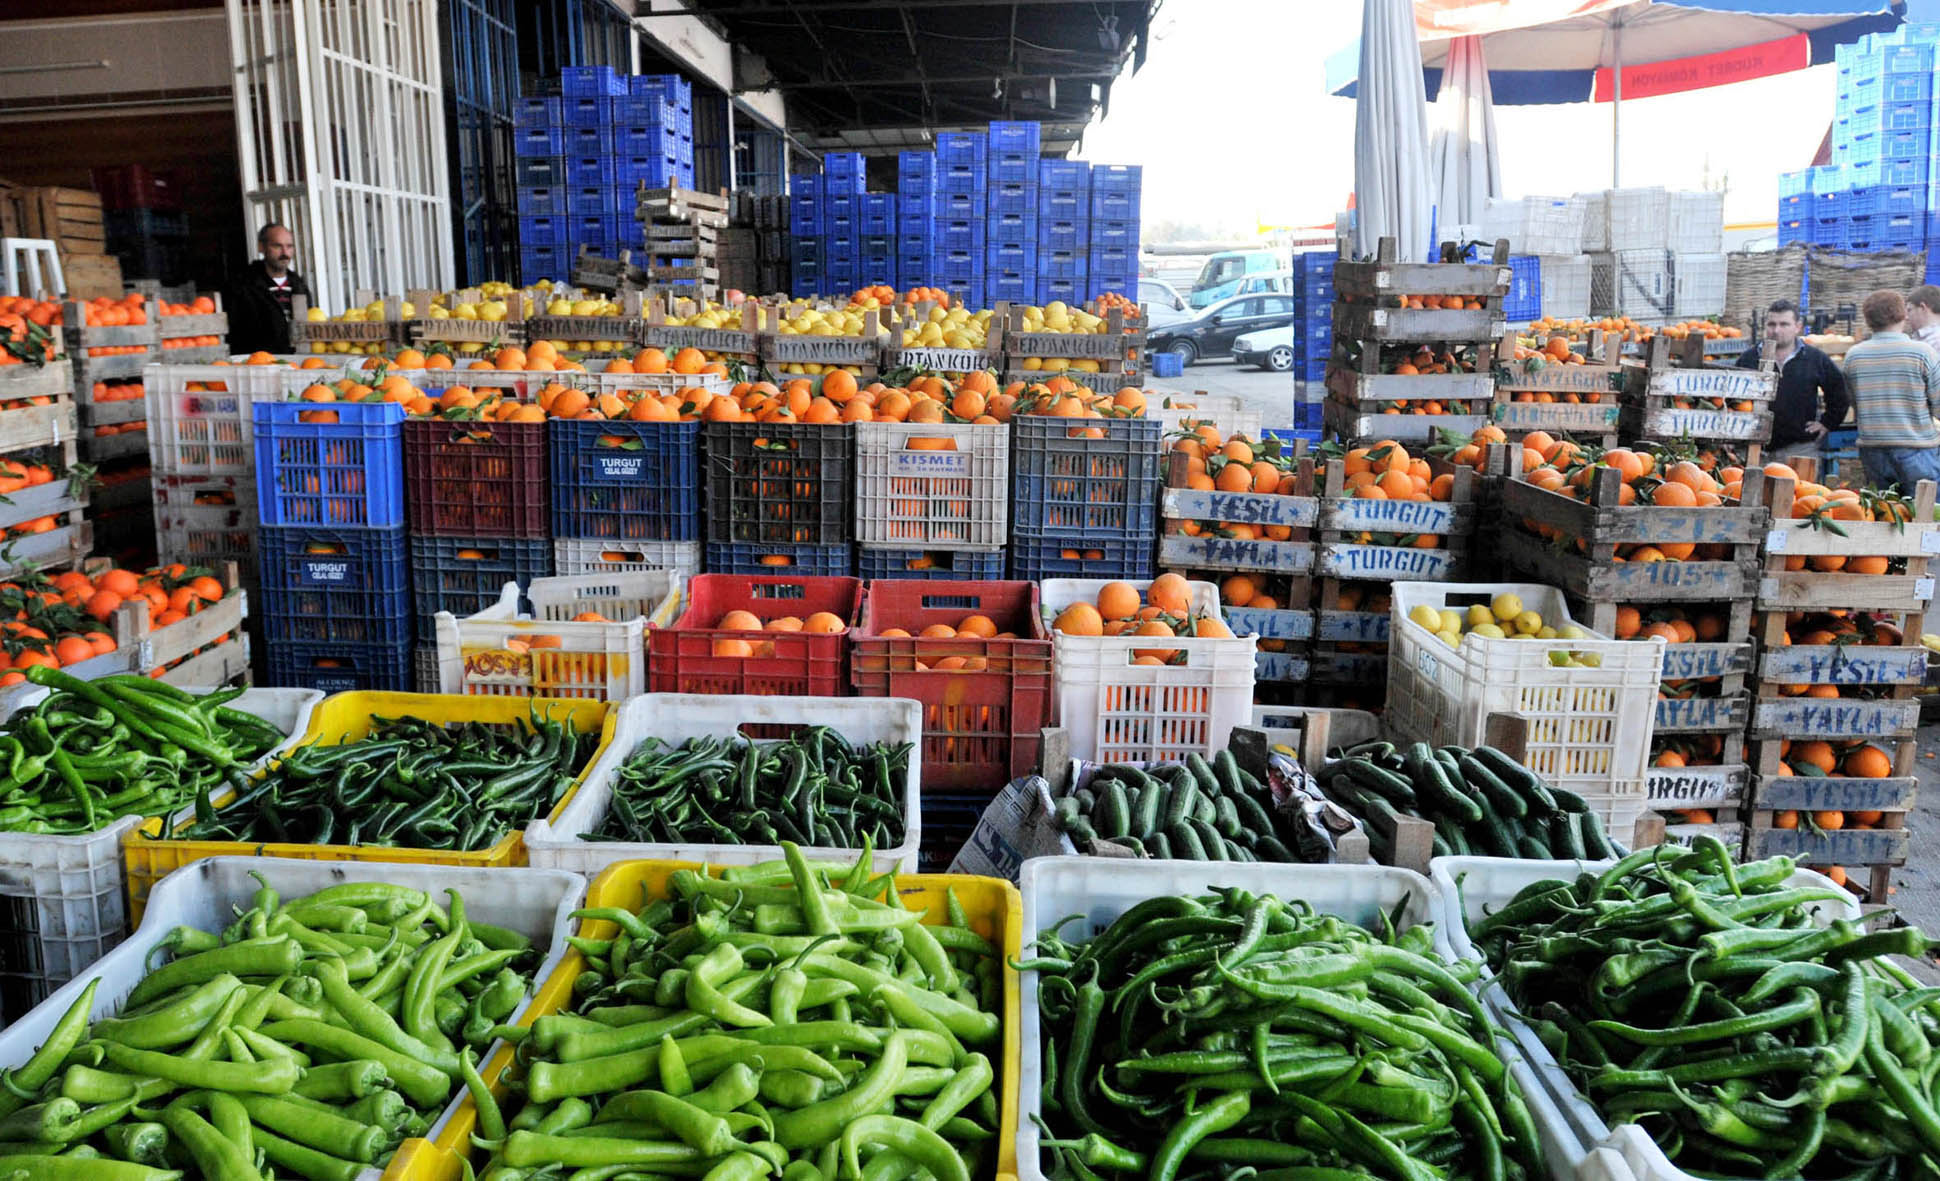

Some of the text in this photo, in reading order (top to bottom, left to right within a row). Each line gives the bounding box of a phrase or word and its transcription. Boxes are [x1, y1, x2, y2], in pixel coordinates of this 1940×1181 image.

[1675, 375, 1751, 395] TURGUT
[1672, 415, 1752, 434] TURGUT
[600, 458, 642, 467] TURGUT
[898, 455, 965, 465] KISMET
[1351, 499, 1446, 530] TURGUT
[1204, 538, 1278, 566] YAYLA
[1347, 549, 1442, 575] TURGUT
[307, 563, 347, 572] TURGUT
[1645, 563, 1702, 586] 105
[1655, 700, 1716, 728] AYLA
[1803, 705, 1882, 734] YAYLA
